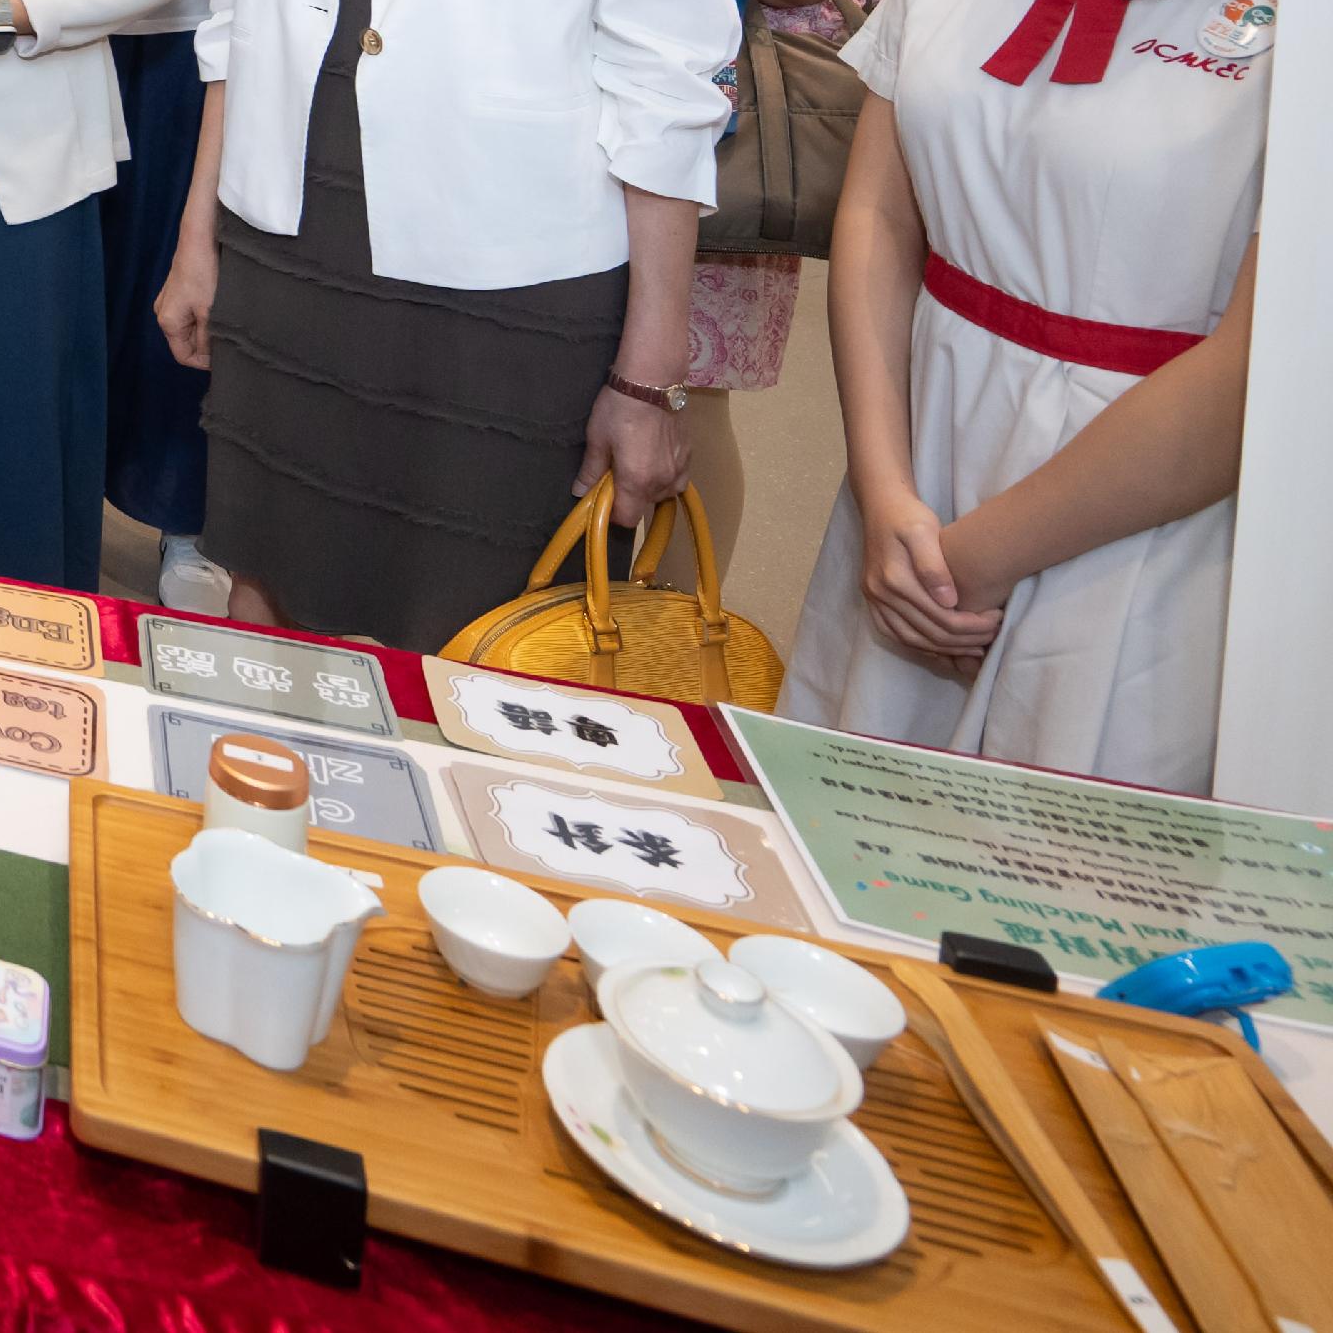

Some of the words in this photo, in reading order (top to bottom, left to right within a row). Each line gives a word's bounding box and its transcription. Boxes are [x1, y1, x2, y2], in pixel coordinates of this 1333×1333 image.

[157, 644, 371, 708] 普通話
[1, 690, 67, 720] tea
[499, 702, 619, 747] 粵語
[546, 814, 683, 869] 茶針
[883, 871, 972, 902] Game
[978, 888, 1127, 934] Matching
